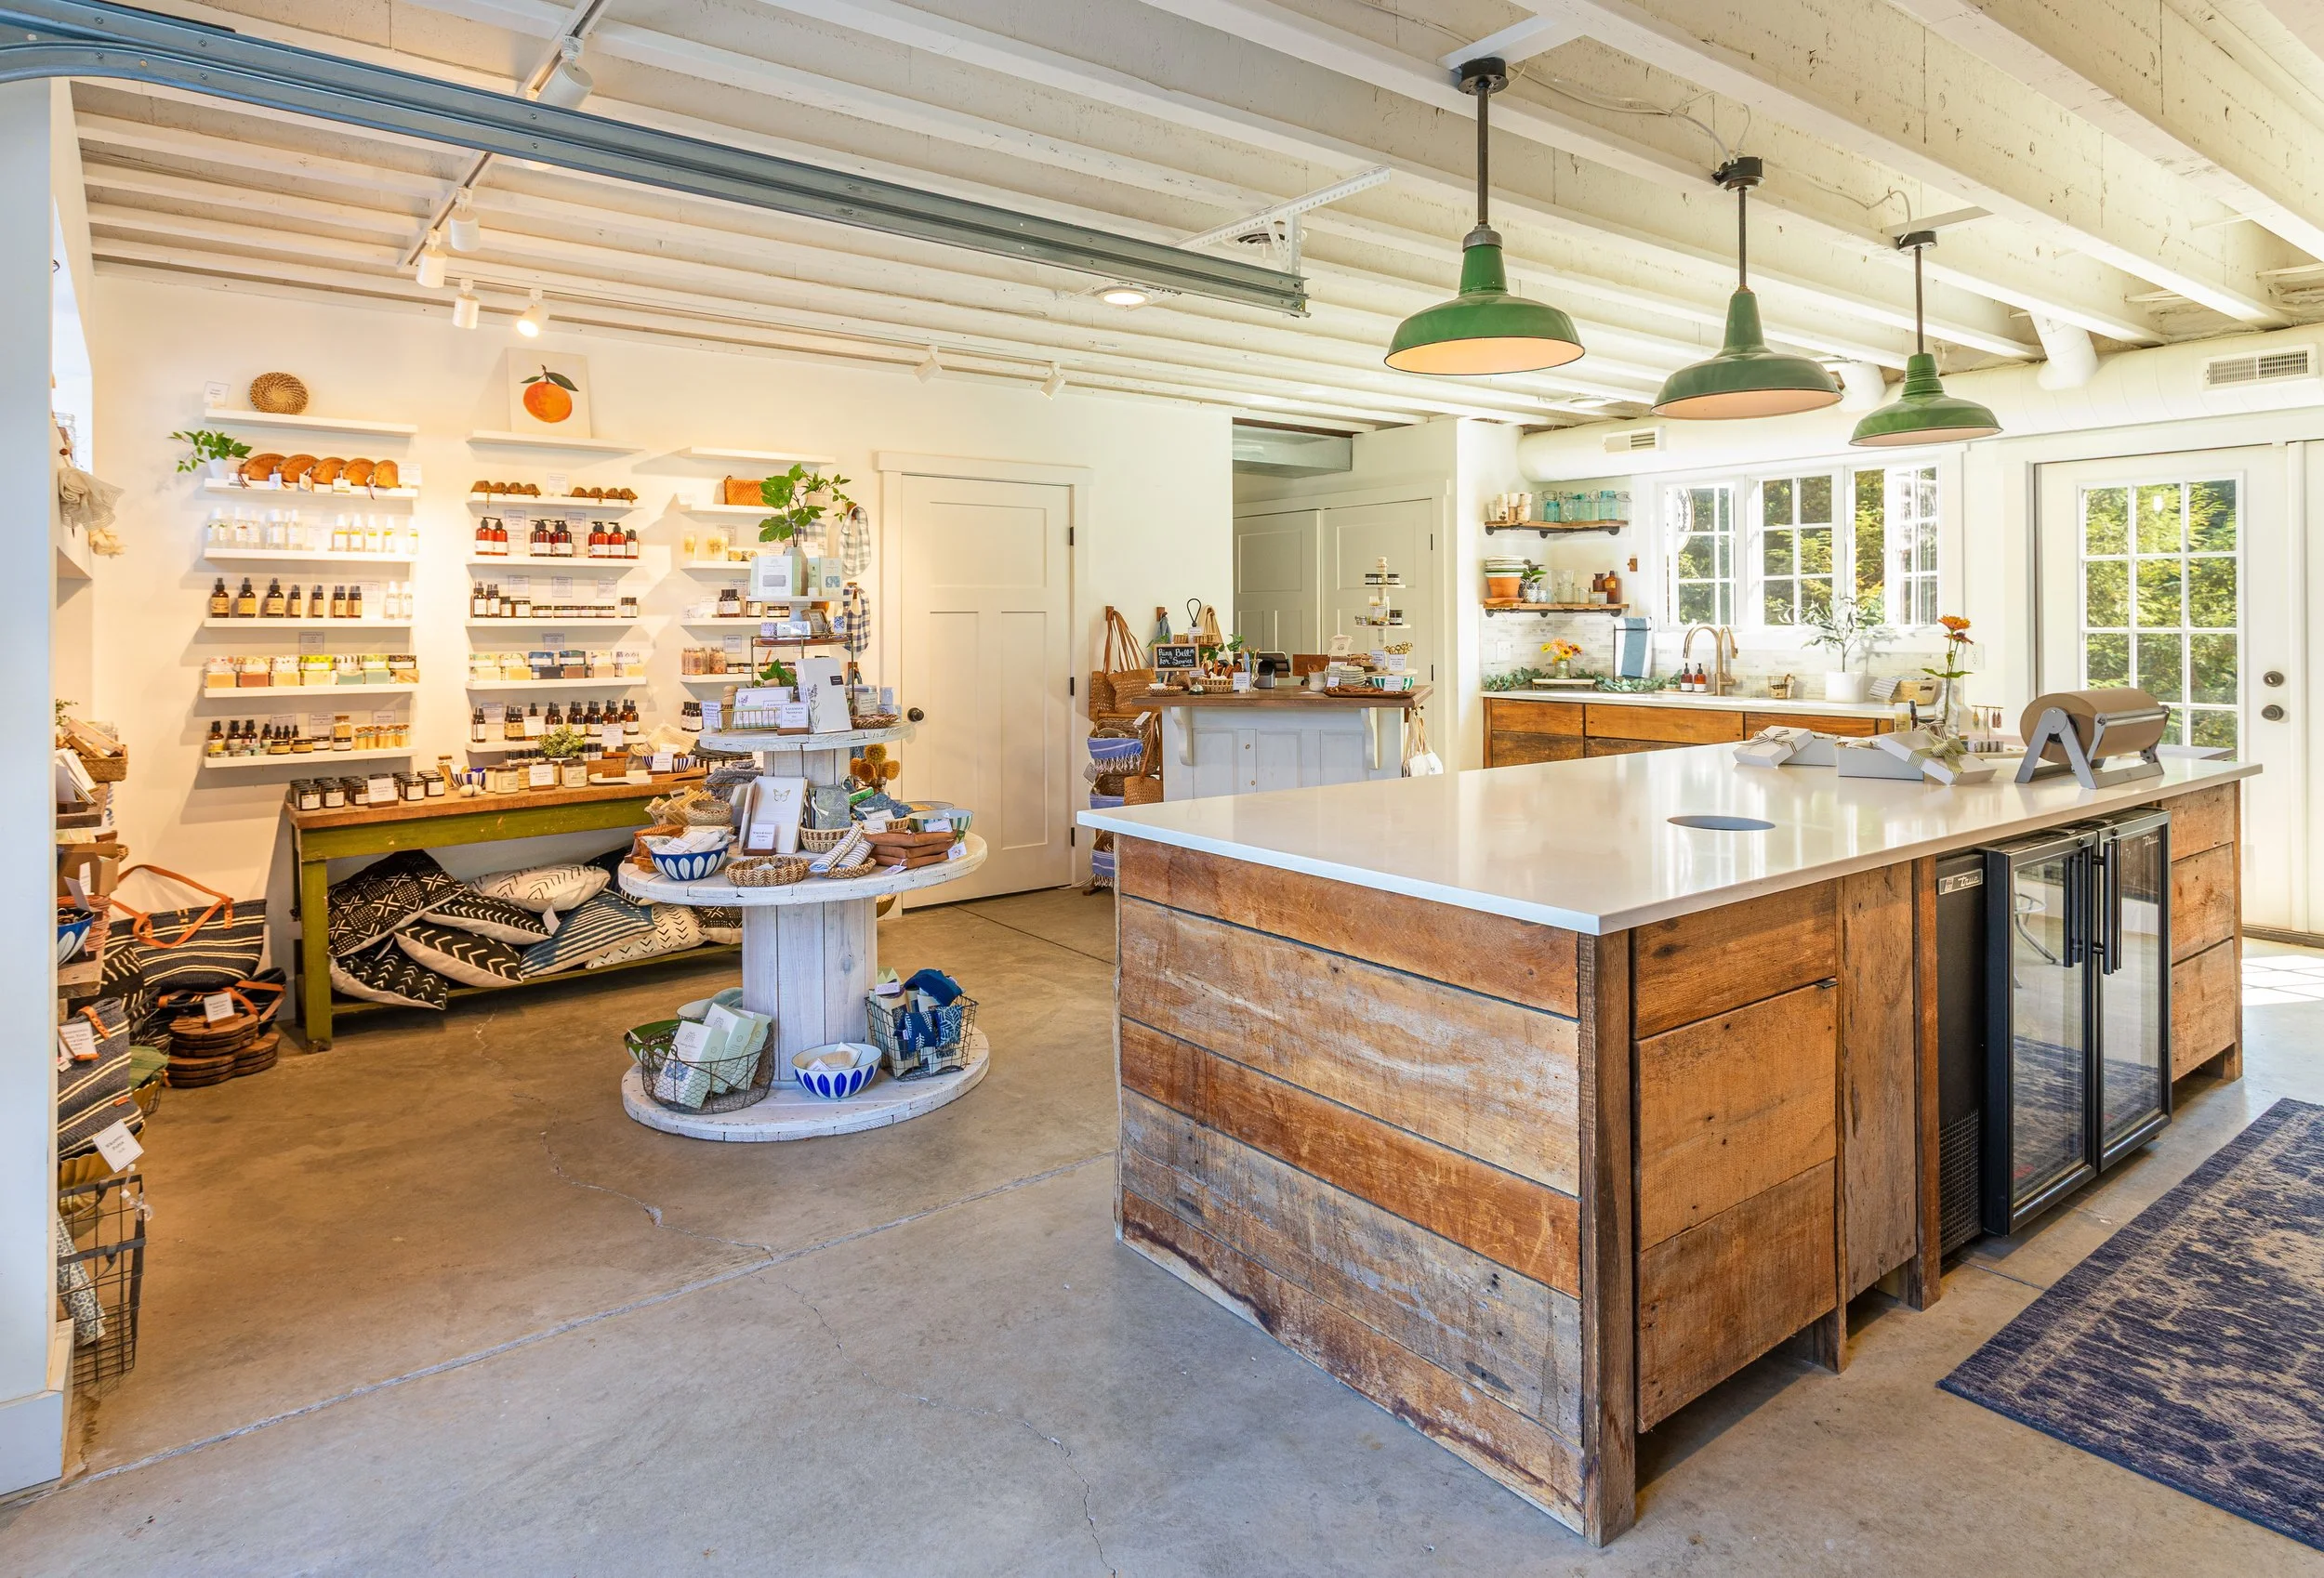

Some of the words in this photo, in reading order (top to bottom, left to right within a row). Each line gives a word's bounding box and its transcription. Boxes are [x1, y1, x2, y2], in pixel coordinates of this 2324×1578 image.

[1158, 648, 1173, 659] Ring
[1175, 648, 1192, 657] Bell
[1171, 656, 1194, 665] Service
